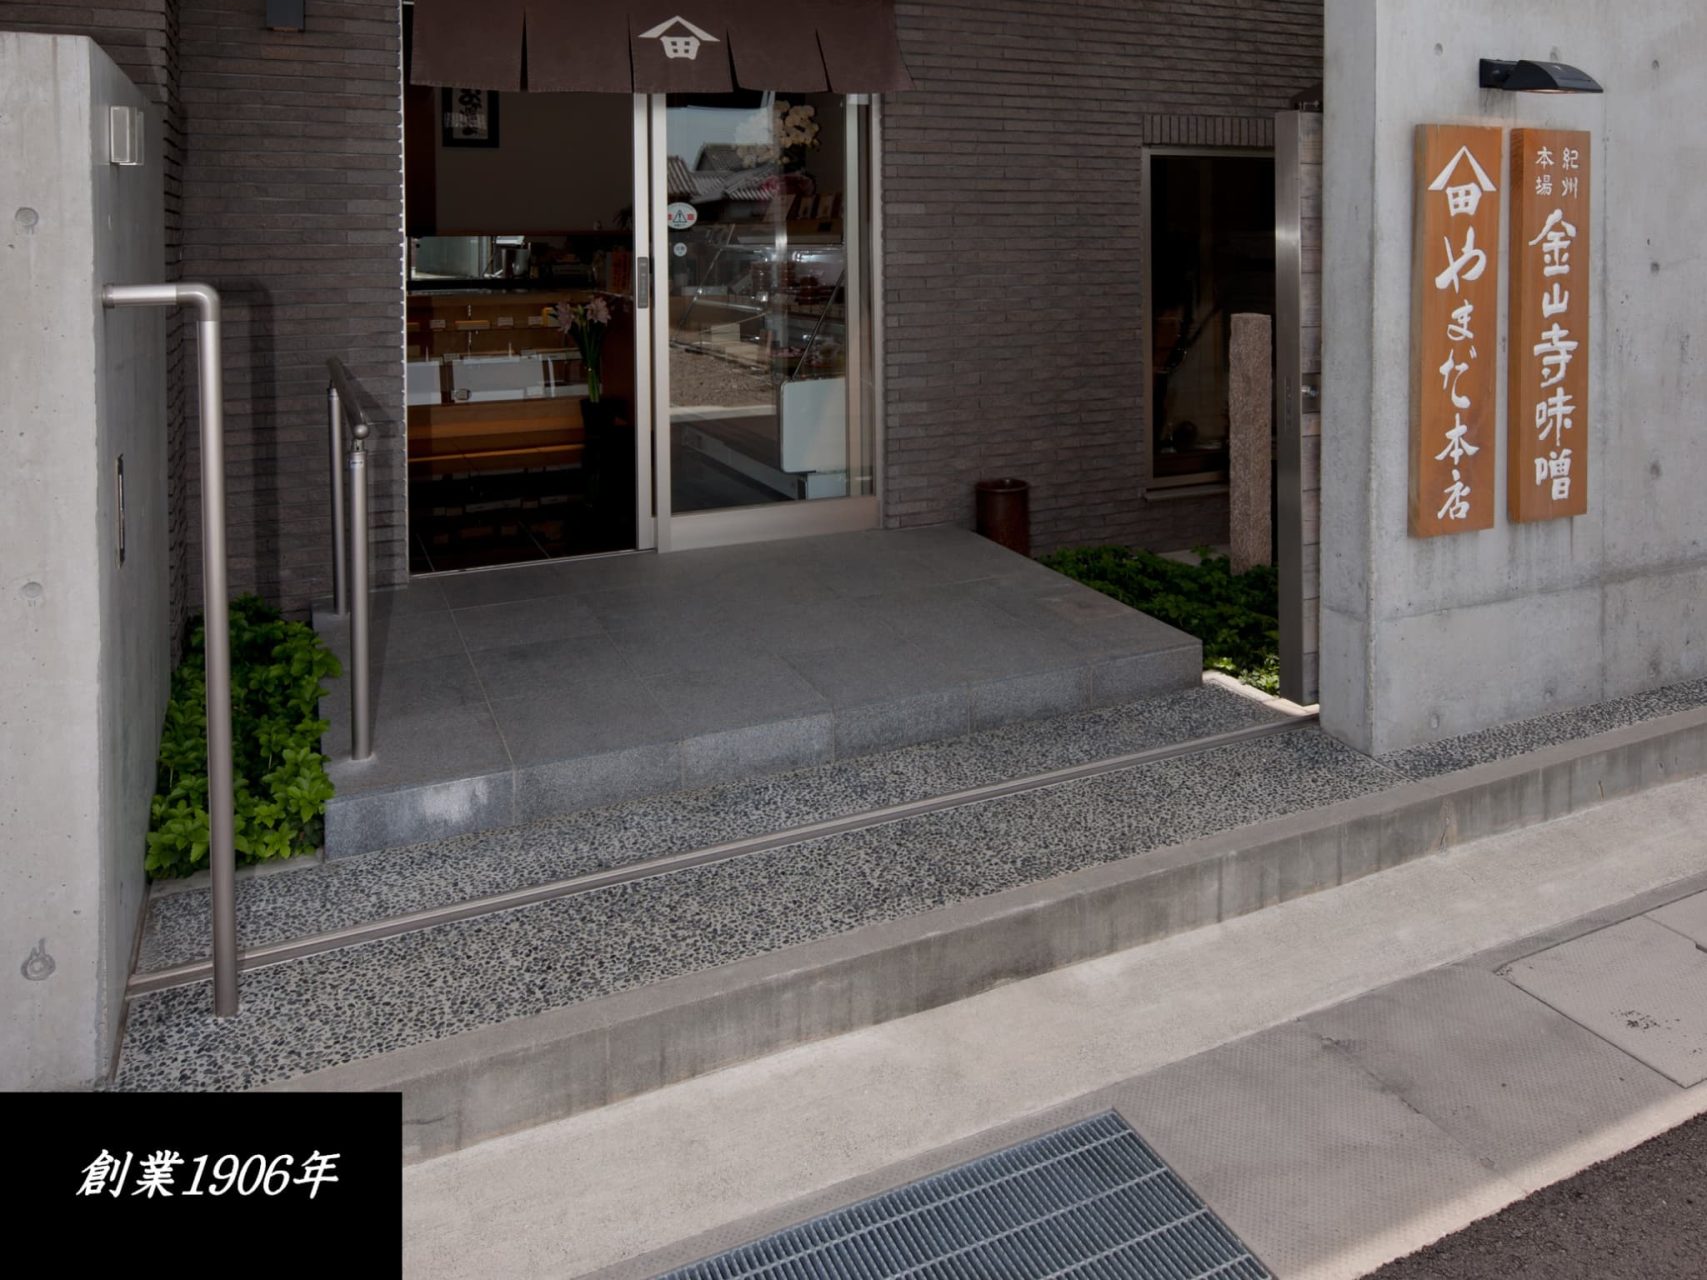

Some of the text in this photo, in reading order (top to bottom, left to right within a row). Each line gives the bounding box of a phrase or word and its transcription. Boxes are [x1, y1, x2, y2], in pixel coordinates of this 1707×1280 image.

[1535, 145, 1555, 196] 本場
[1561, 147, 1580, 199] 紀州
[1434, 225, 1488, 521] やまだ本店
[1529, 207, 1579, 501] 金山寺味噌
